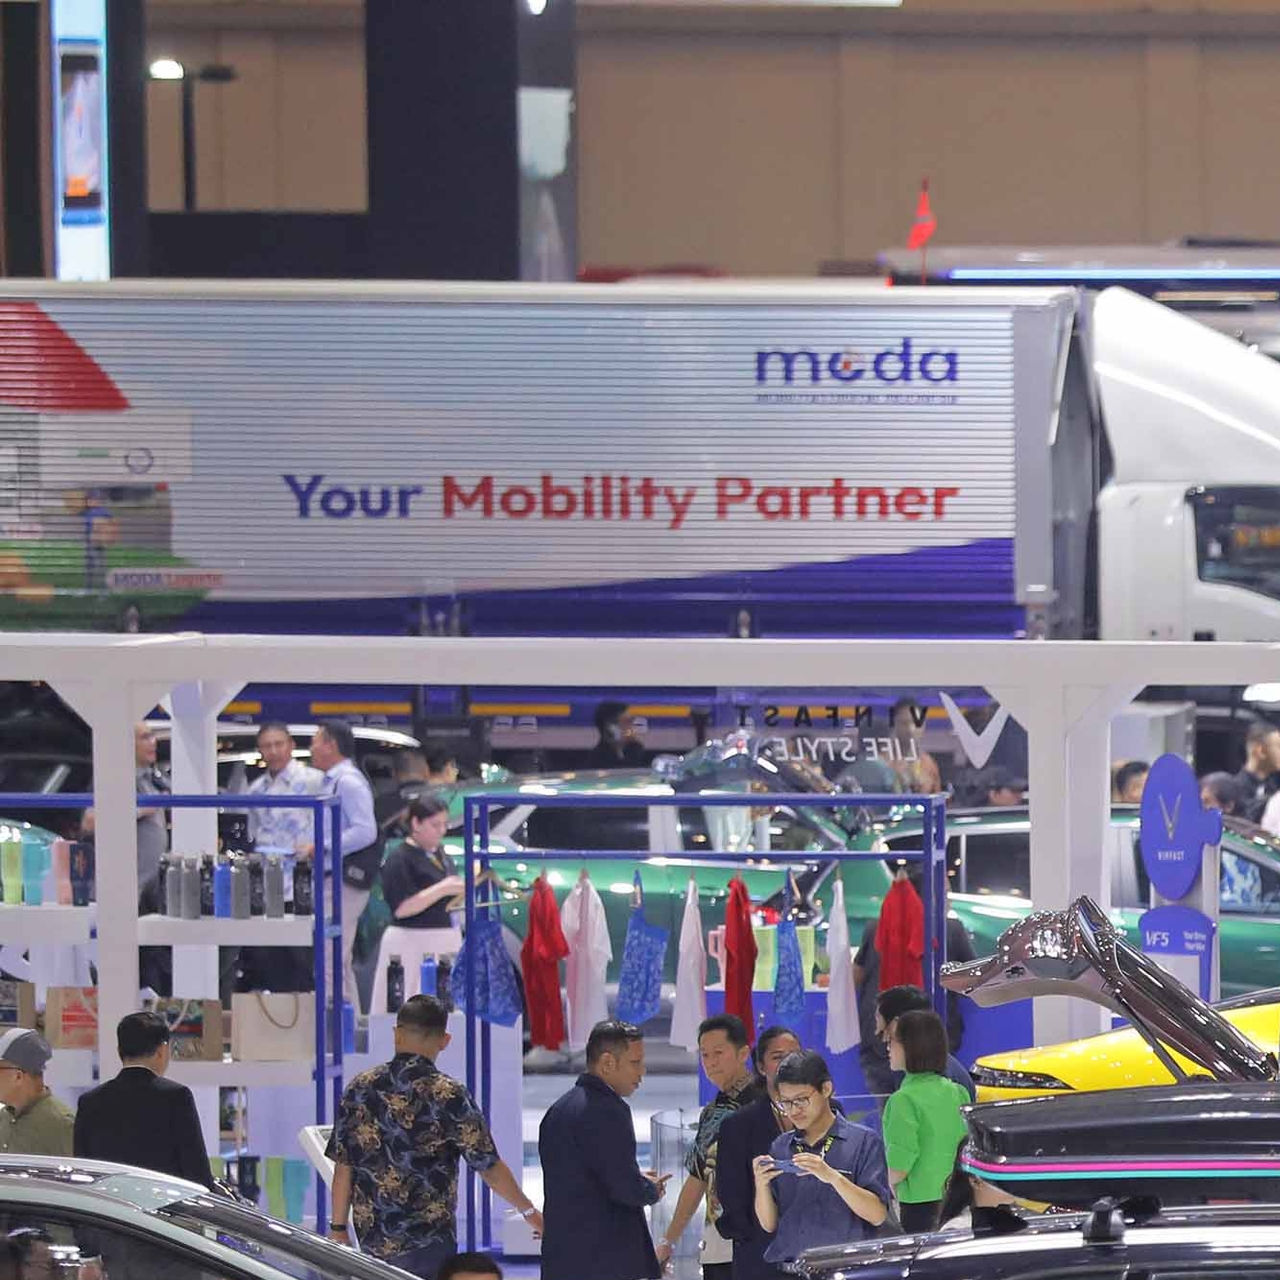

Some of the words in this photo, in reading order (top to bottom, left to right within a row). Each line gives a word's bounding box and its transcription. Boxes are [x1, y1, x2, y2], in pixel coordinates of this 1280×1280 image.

[282, 475, 423, 519] Your
[442, 473, 697, 530] Mobility
[715, 476, 958, 520] Partner
